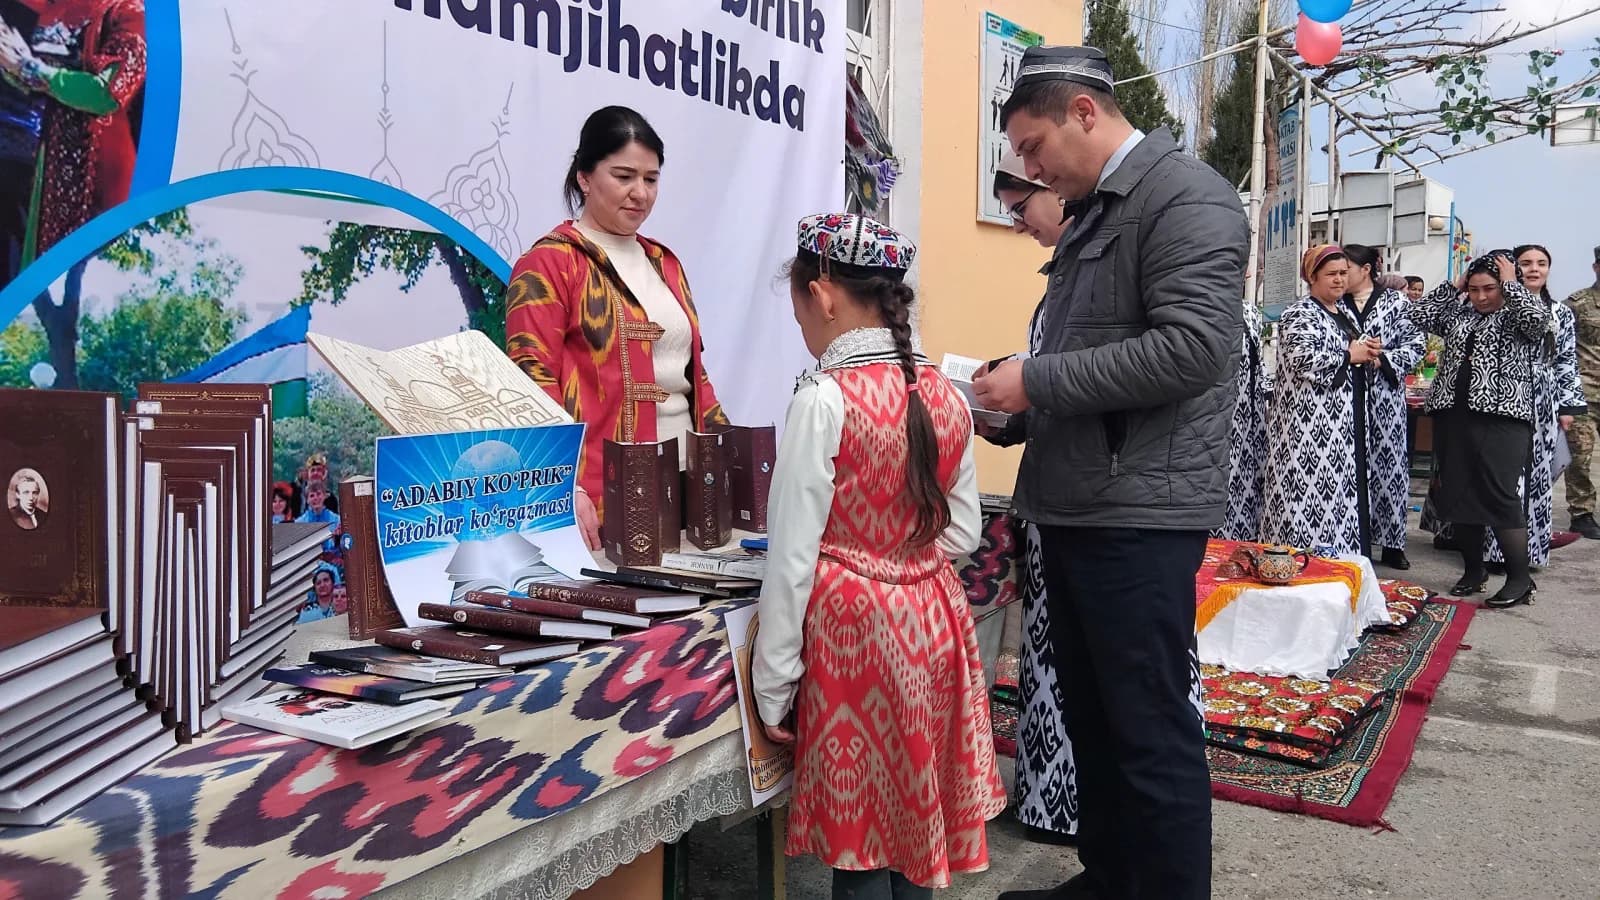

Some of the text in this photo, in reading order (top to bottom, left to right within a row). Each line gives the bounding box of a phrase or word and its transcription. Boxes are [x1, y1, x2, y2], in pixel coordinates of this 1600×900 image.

[721, 0, 825, 54] rlik
[394, 0, 806, 132] amjihatlikda
[382, 478, 479, 509] “ADABIY
[385, 492, 571, 547] kitoblar ko‘rgazmasi
